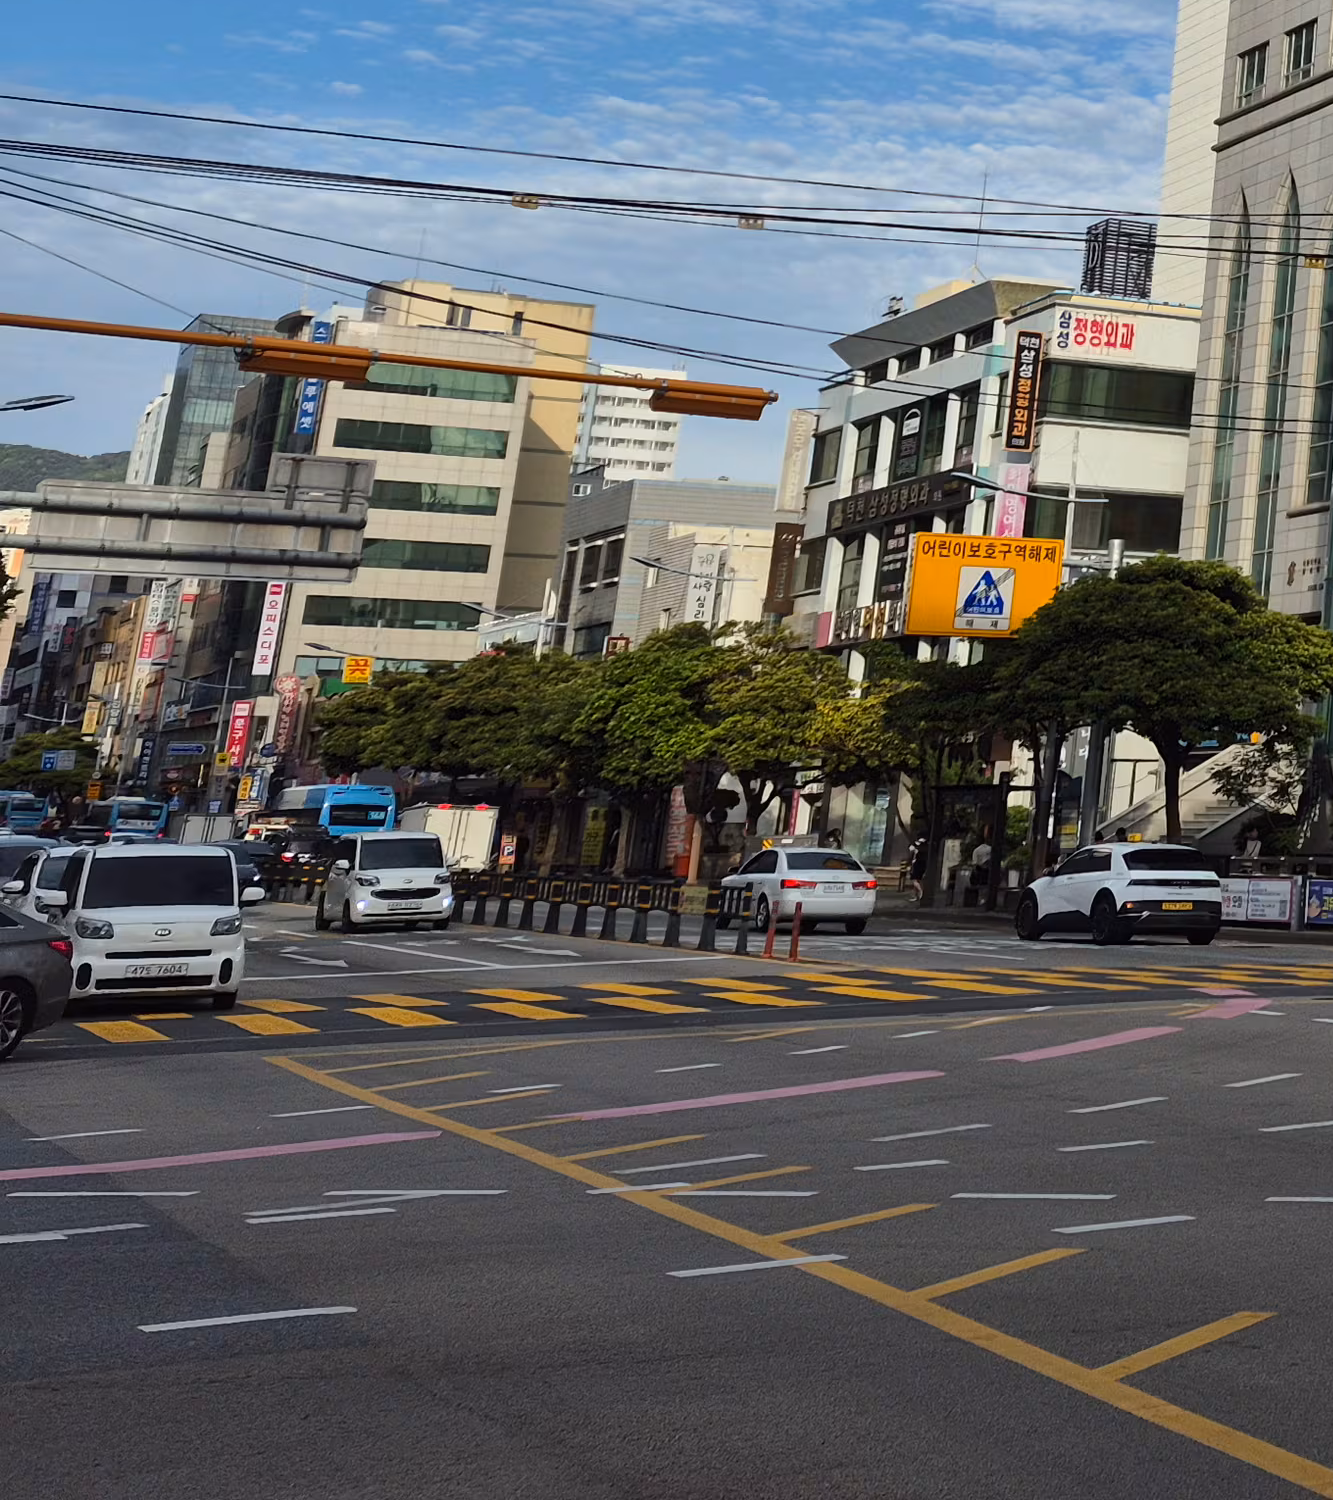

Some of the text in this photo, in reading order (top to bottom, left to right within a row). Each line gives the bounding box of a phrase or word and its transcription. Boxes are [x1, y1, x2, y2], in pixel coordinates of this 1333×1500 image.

[1057, 310, 1072, 349] 삼성
[1074, 317, 1136, 351] 정형외과
[922, 538, 1057, 564] 어린이보호구역해제
[257, 599, 279, 665] 오피스디포
[347, 658, 370, 675] 꽃
